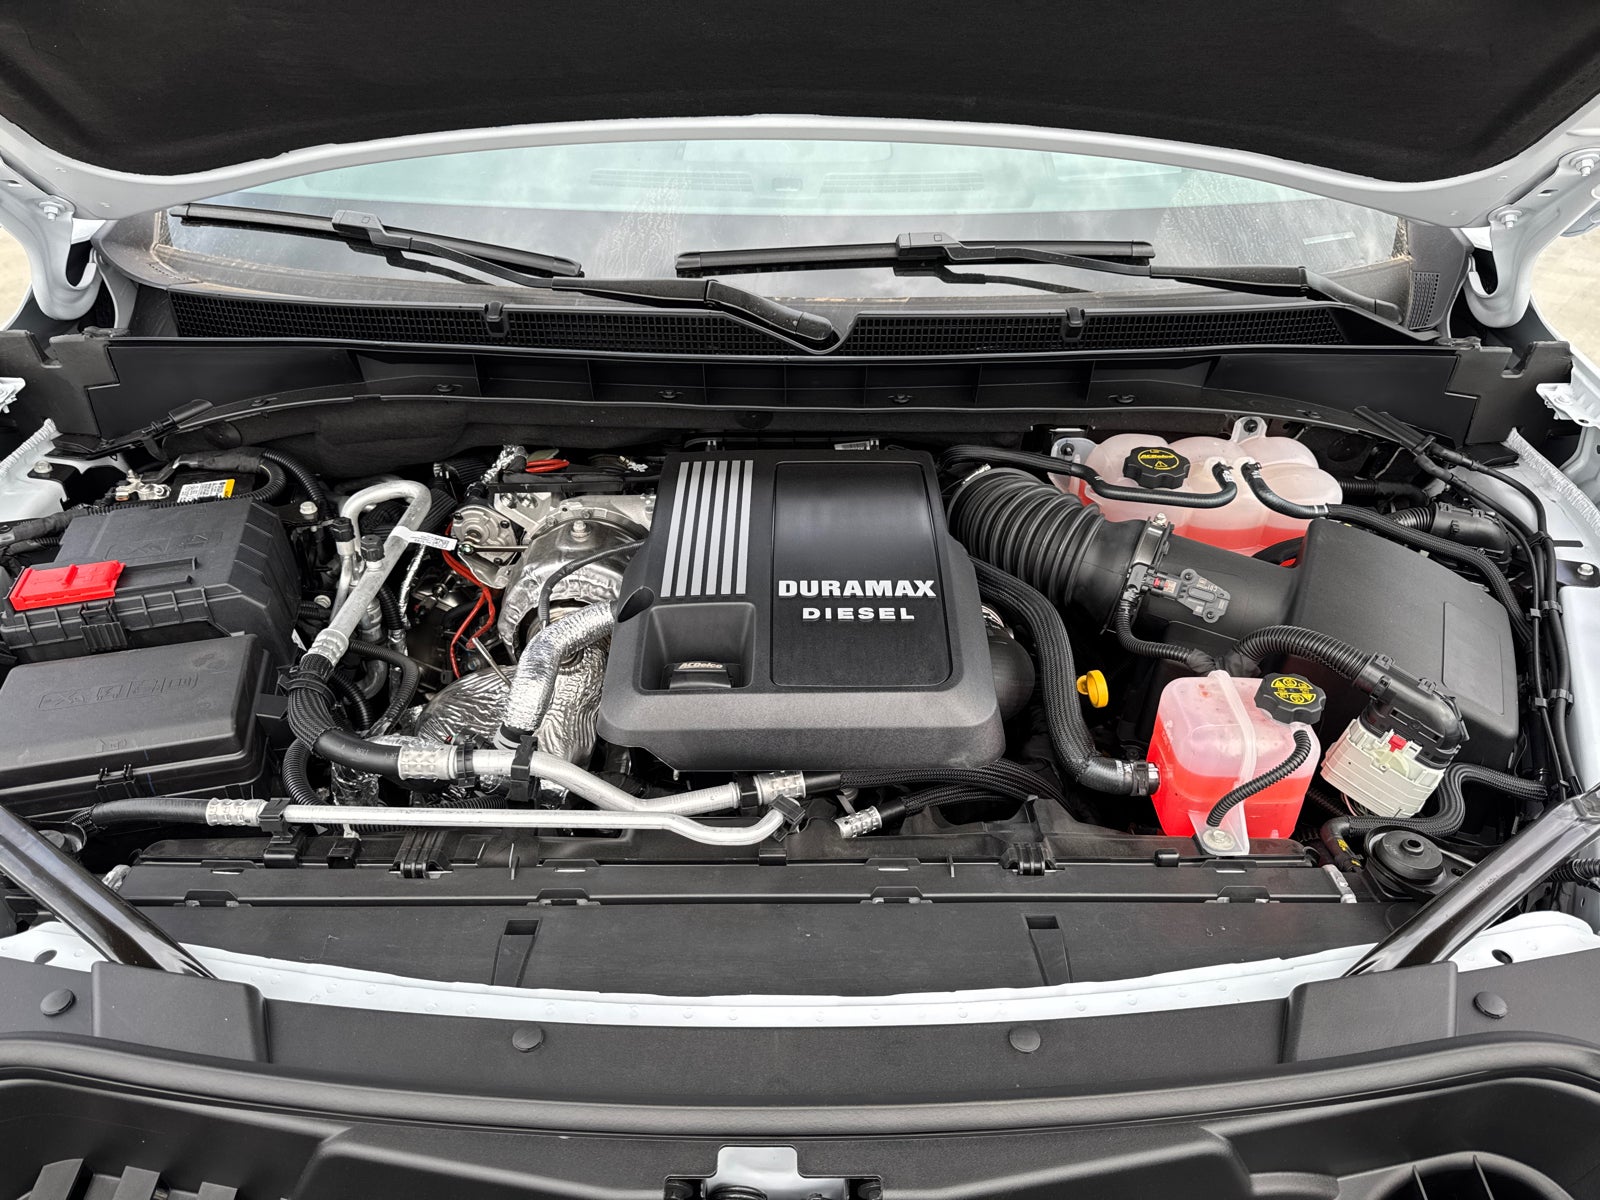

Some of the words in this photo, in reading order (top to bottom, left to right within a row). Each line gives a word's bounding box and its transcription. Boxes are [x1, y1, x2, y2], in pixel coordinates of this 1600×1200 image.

[778, 580, 937, 598] DURAMAX
[802, 607, 915, 621] DIESEL
[678, 661, 723, 670] ACDelco
